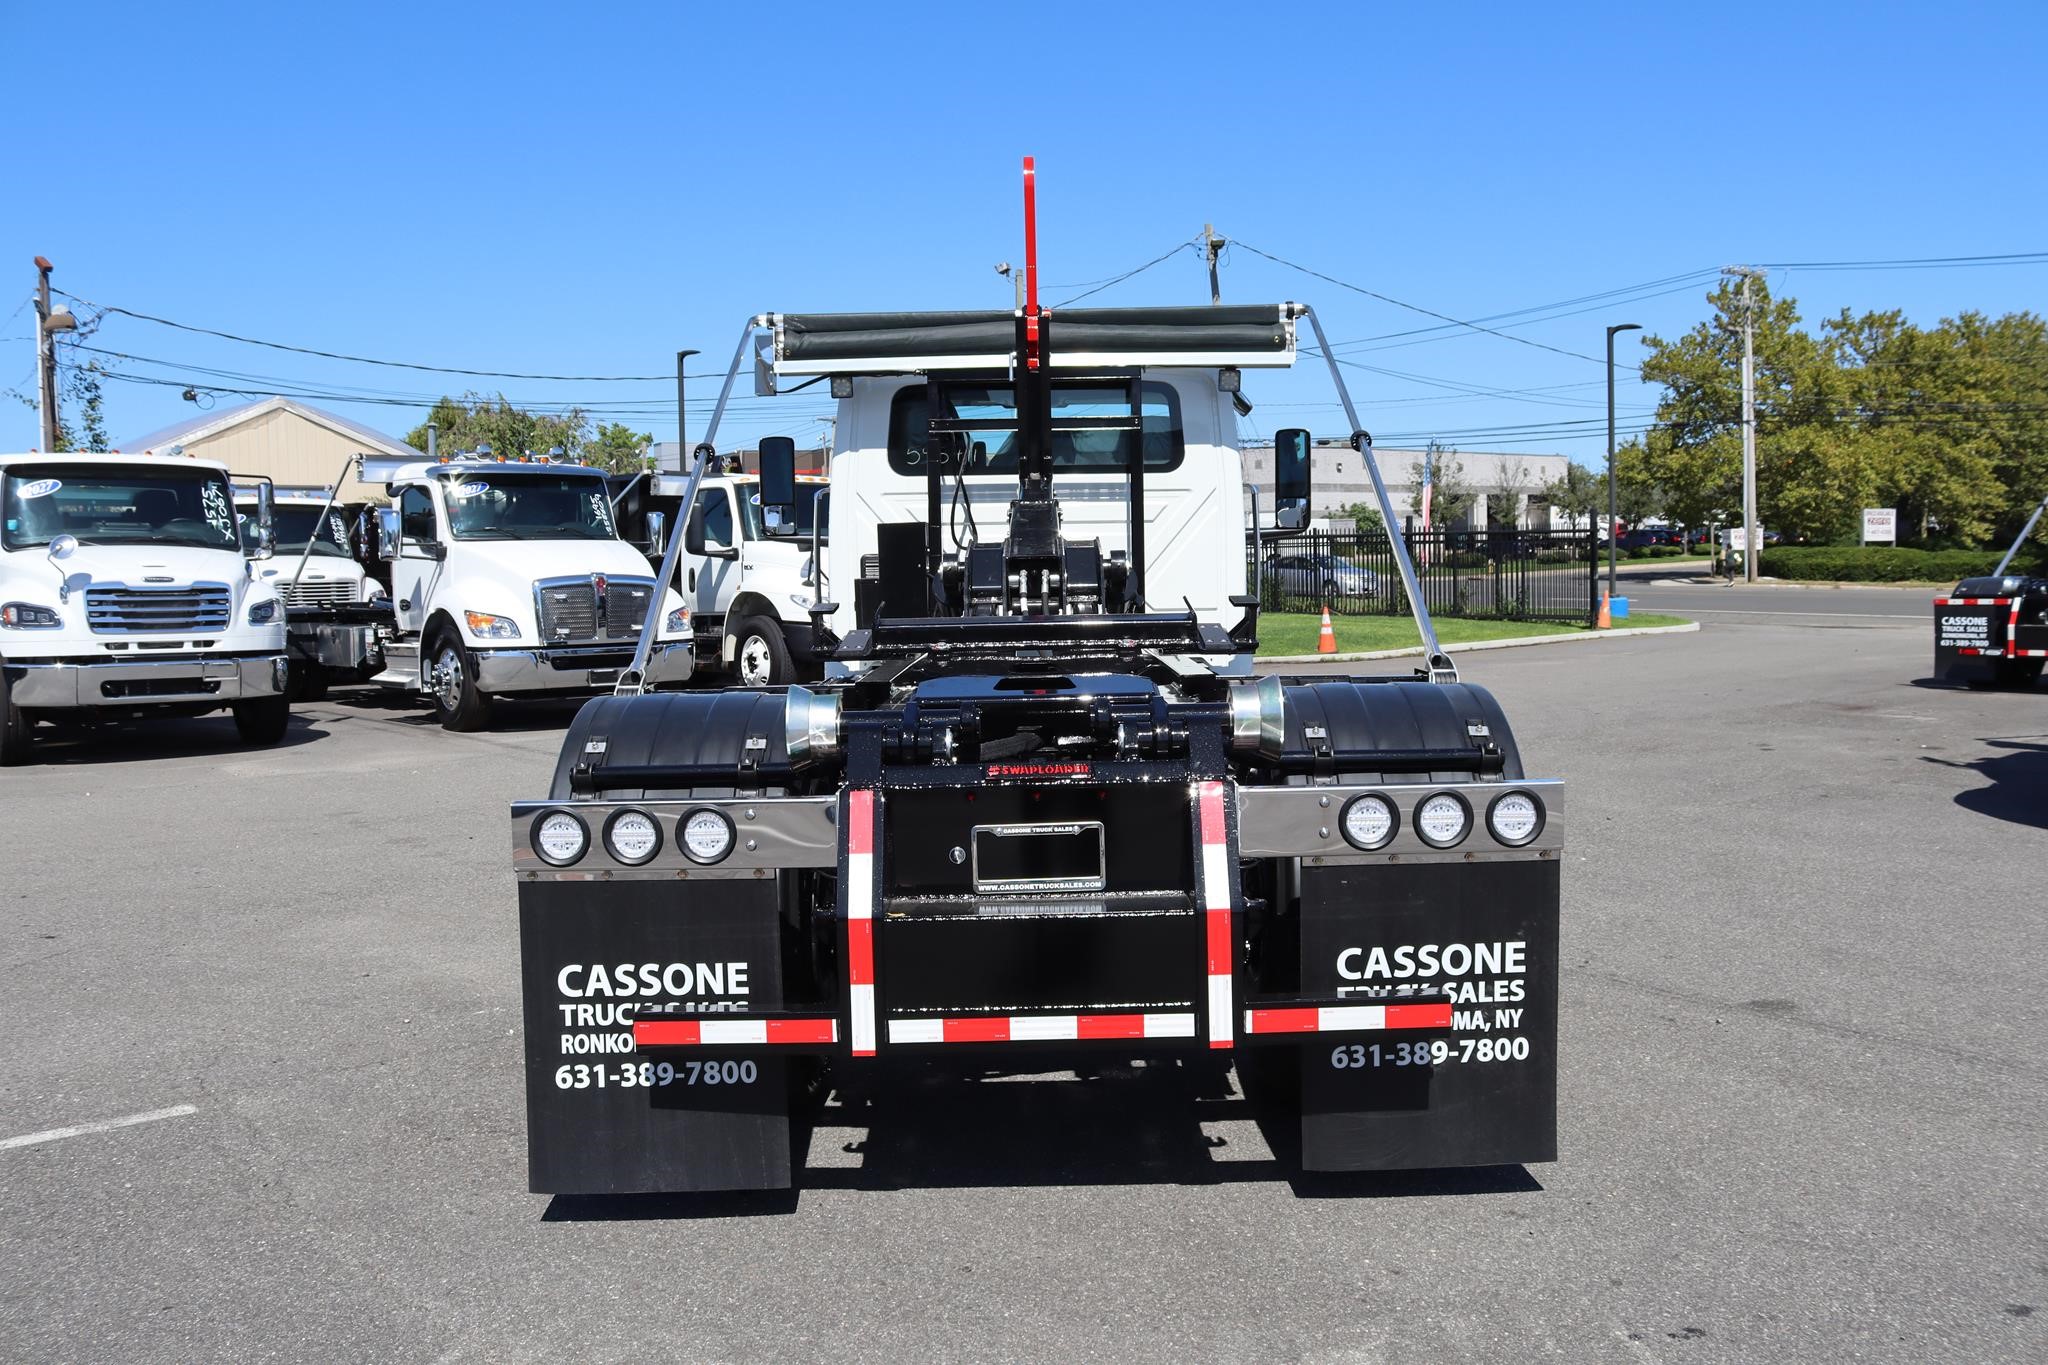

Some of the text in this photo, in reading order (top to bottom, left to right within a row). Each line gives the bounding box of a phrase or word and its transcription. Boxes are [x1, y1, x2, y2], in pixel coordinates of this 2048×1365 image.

[1941, 616, 1988, 626] CASSONE
[1002, 763, 1089, 775] SWAPLOADER
[978, 881, 1102, 892] WWW.CASSONETRUCKSALES.COM
[1336, 941, 1527, 980] CASSONE
[557, 961, 750, 998] CASSONE
[1451, 1008, 1524, 1032] MA, NY
[561, 1032, 637, 1055] RONKO
[1331, 1037, 1529, 1069] 631-389-7800
[555, 1059, 758, 1089] 631-389-7800
